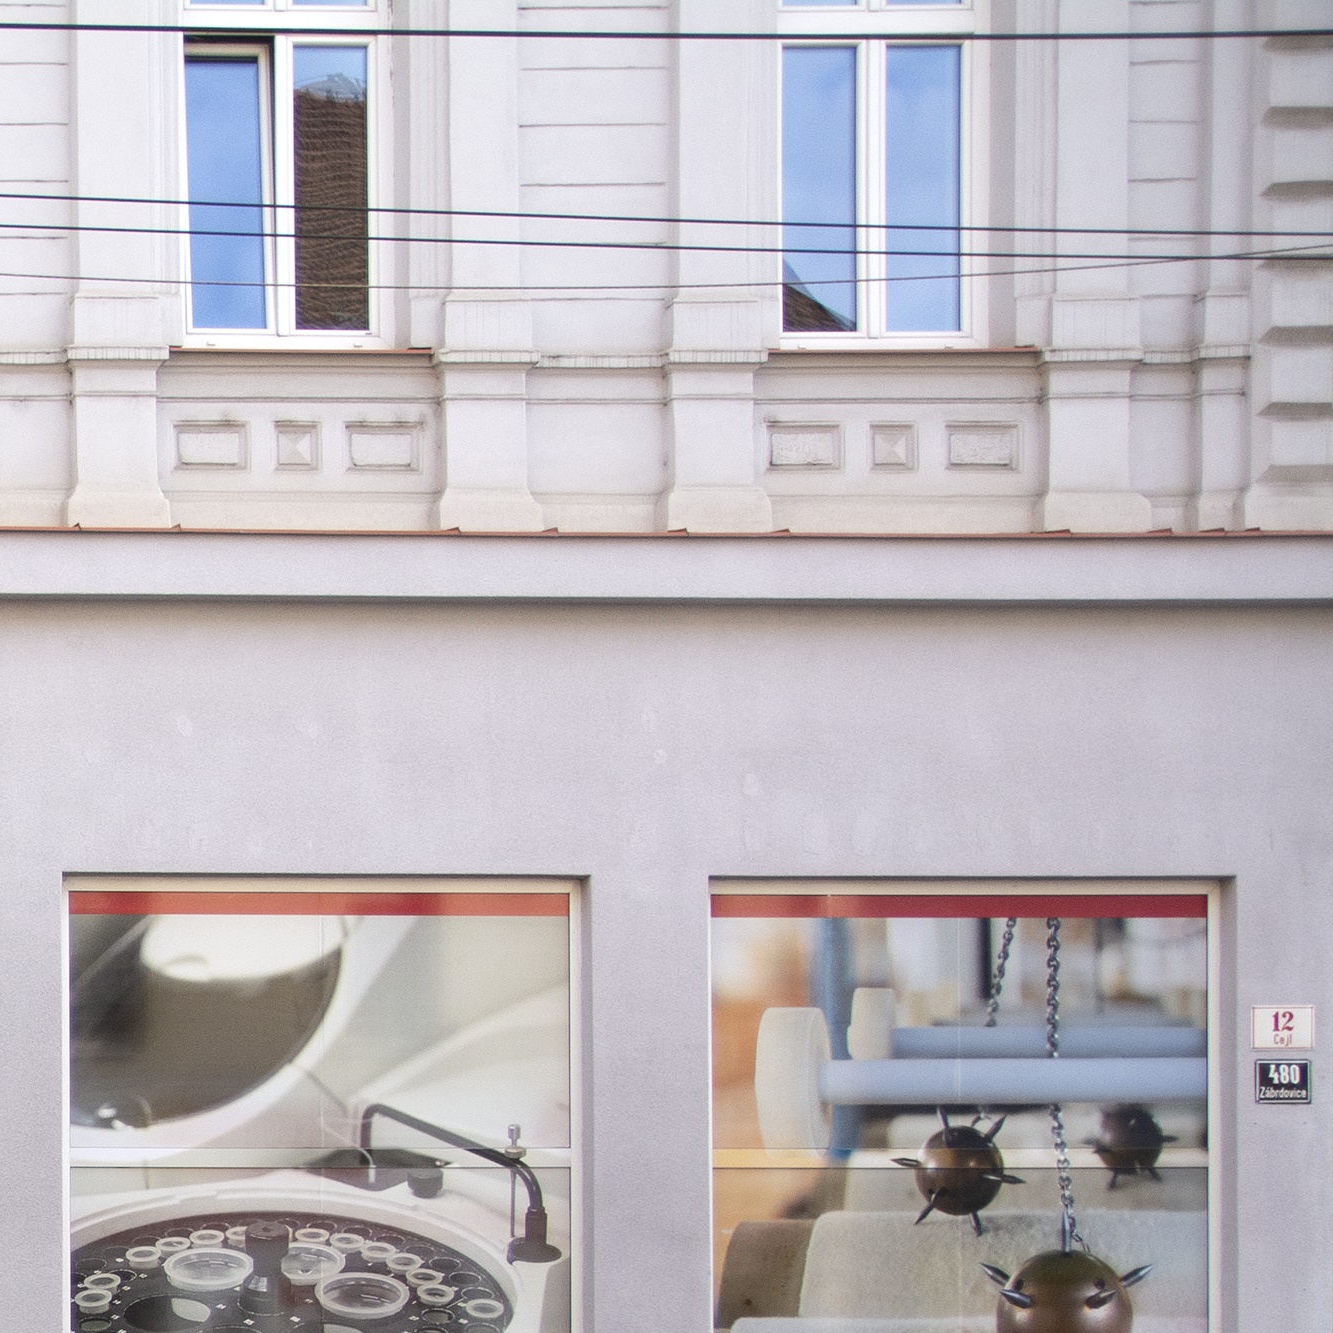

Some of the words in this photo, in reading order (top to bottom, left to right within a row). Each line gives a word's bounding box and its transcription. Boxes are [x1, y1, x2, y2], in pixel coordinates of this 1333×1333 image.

[1272, 1011, 1294, 1032] 12
[1273, 1033, 1293, 1047] Cejl
[1268, 1064, 1301, 1085] 480
[1259, 1086, 1307, 1099] Zábrdovice
